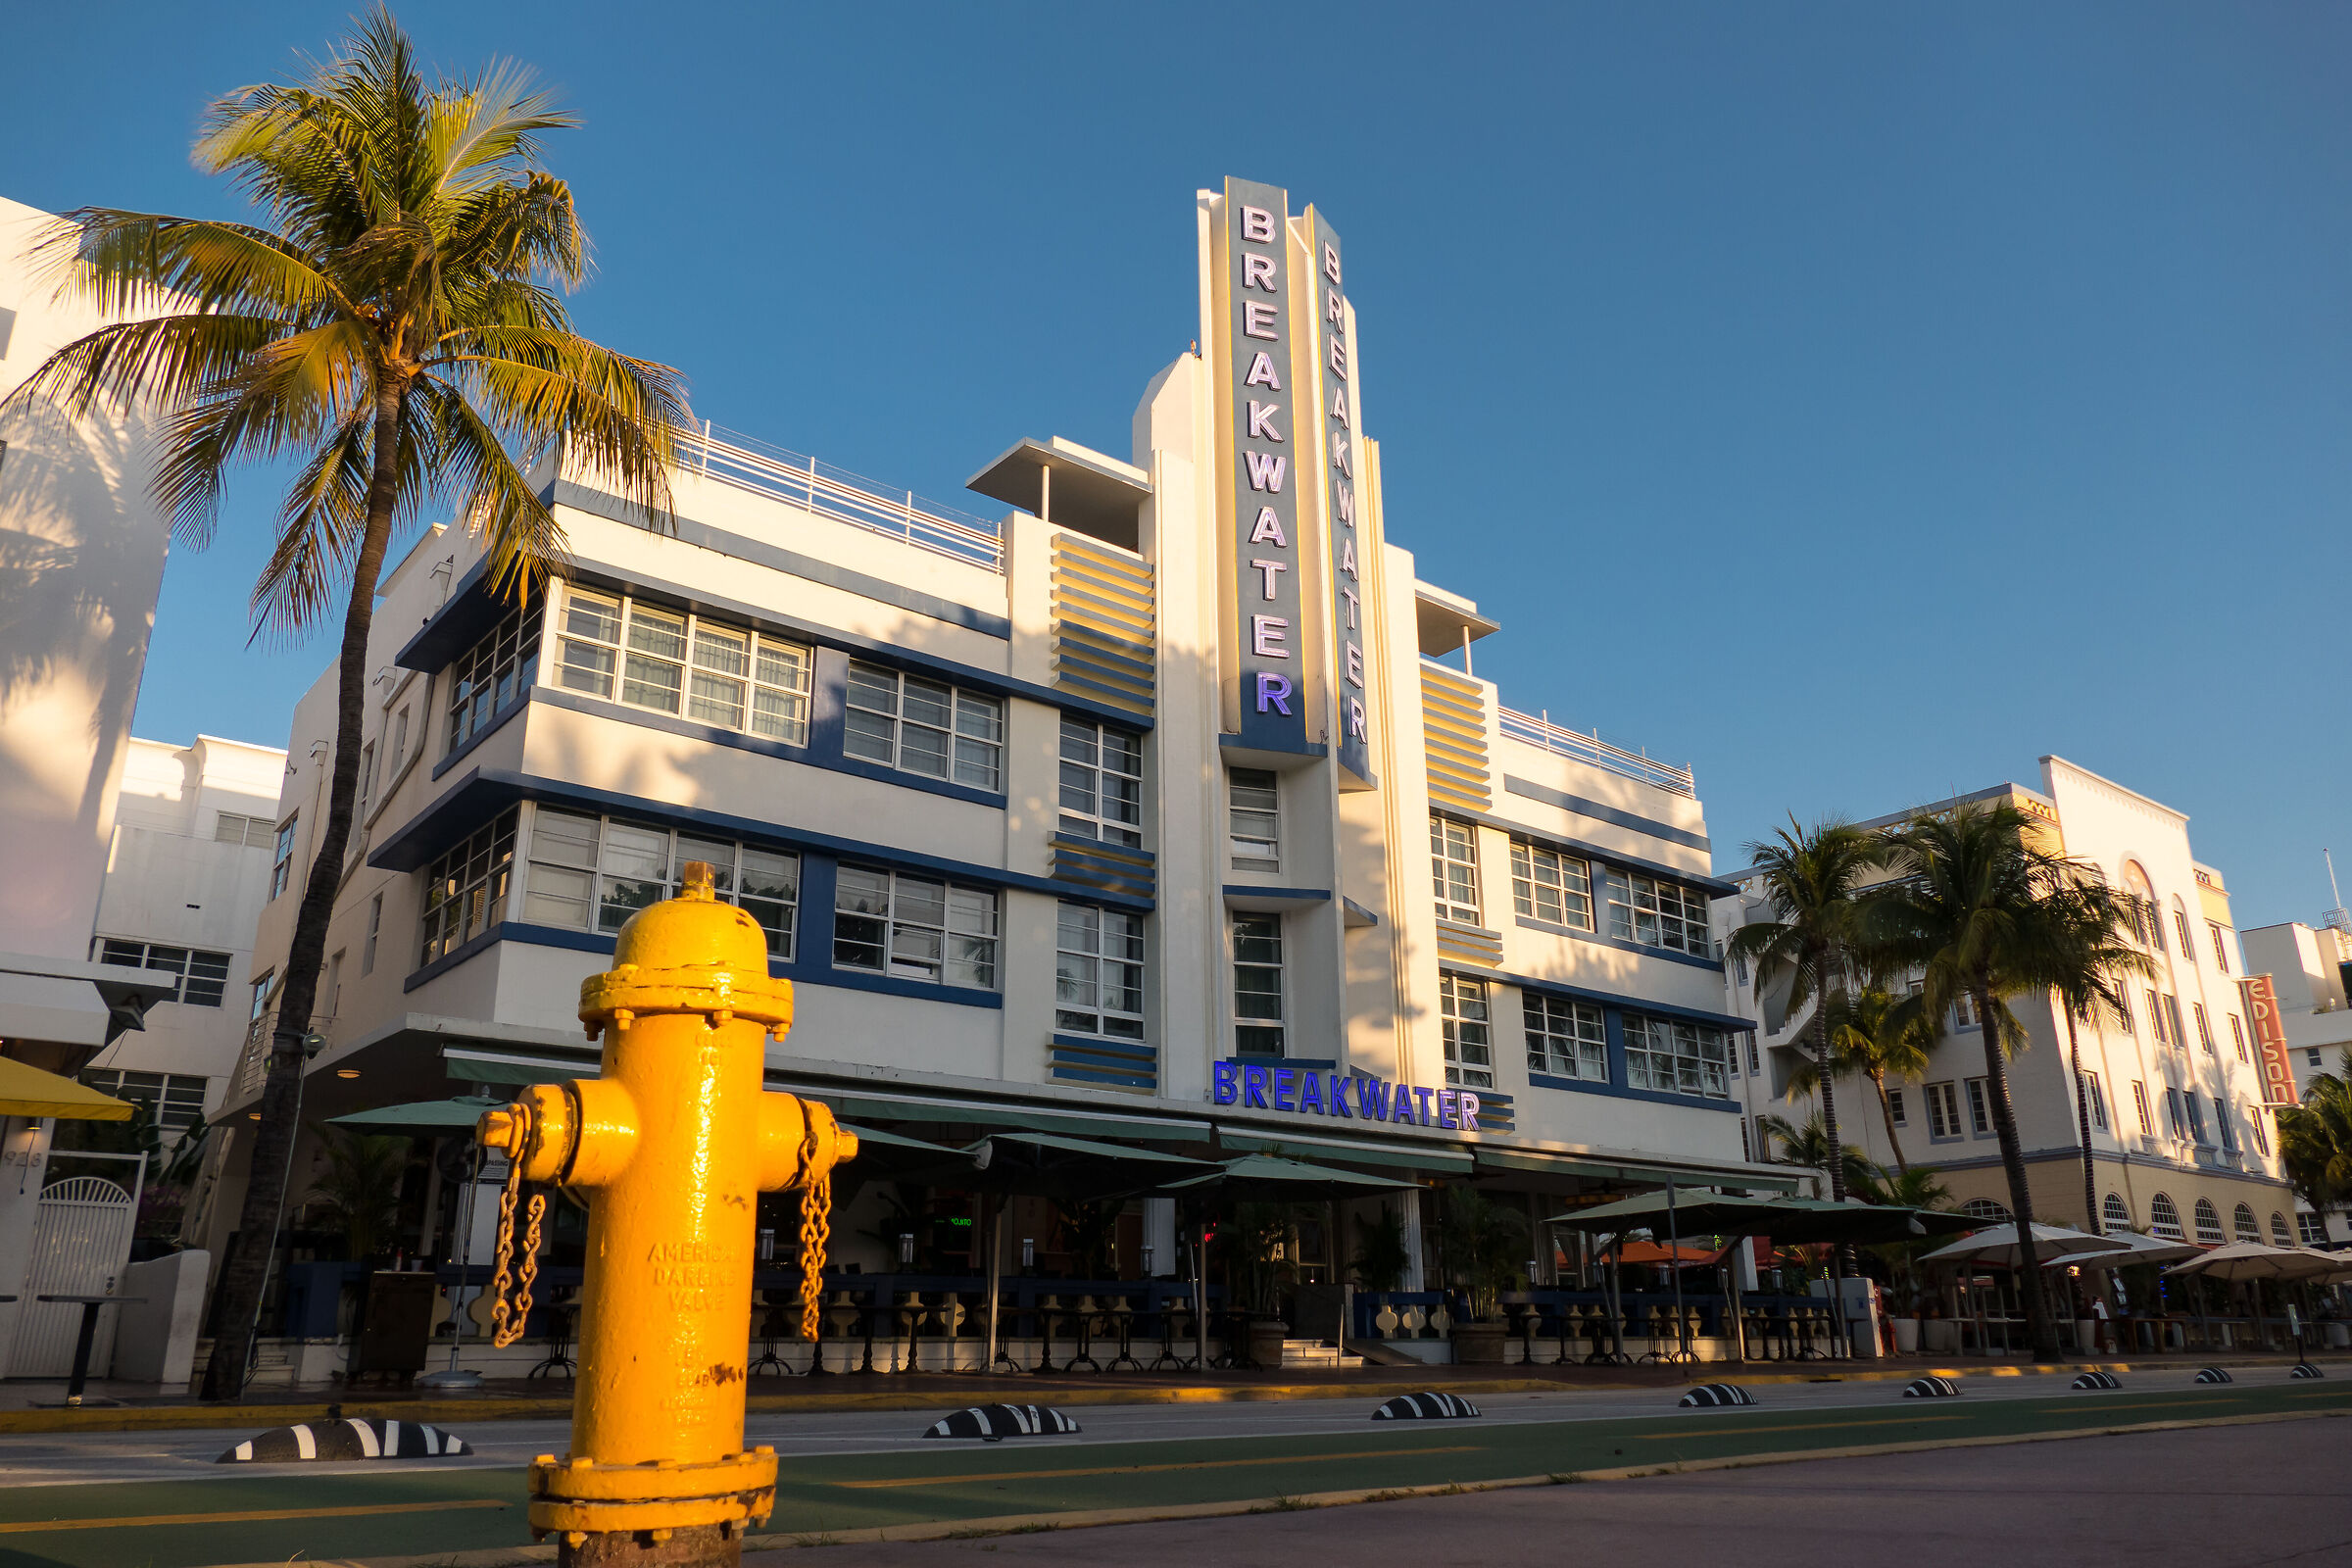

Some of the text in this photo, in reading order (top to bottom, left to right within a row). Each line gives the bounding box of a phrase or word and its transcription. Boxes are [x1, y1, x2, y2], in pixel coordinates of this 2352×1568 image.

[1242, 205, 1293, 715] BREAKWATER
[1323, 240, 1366, 745] BREAKWATER
[1214, 1060, 1482, 1132] BREAKWATER
[2248, 979, 2289, 1102] EDISON
